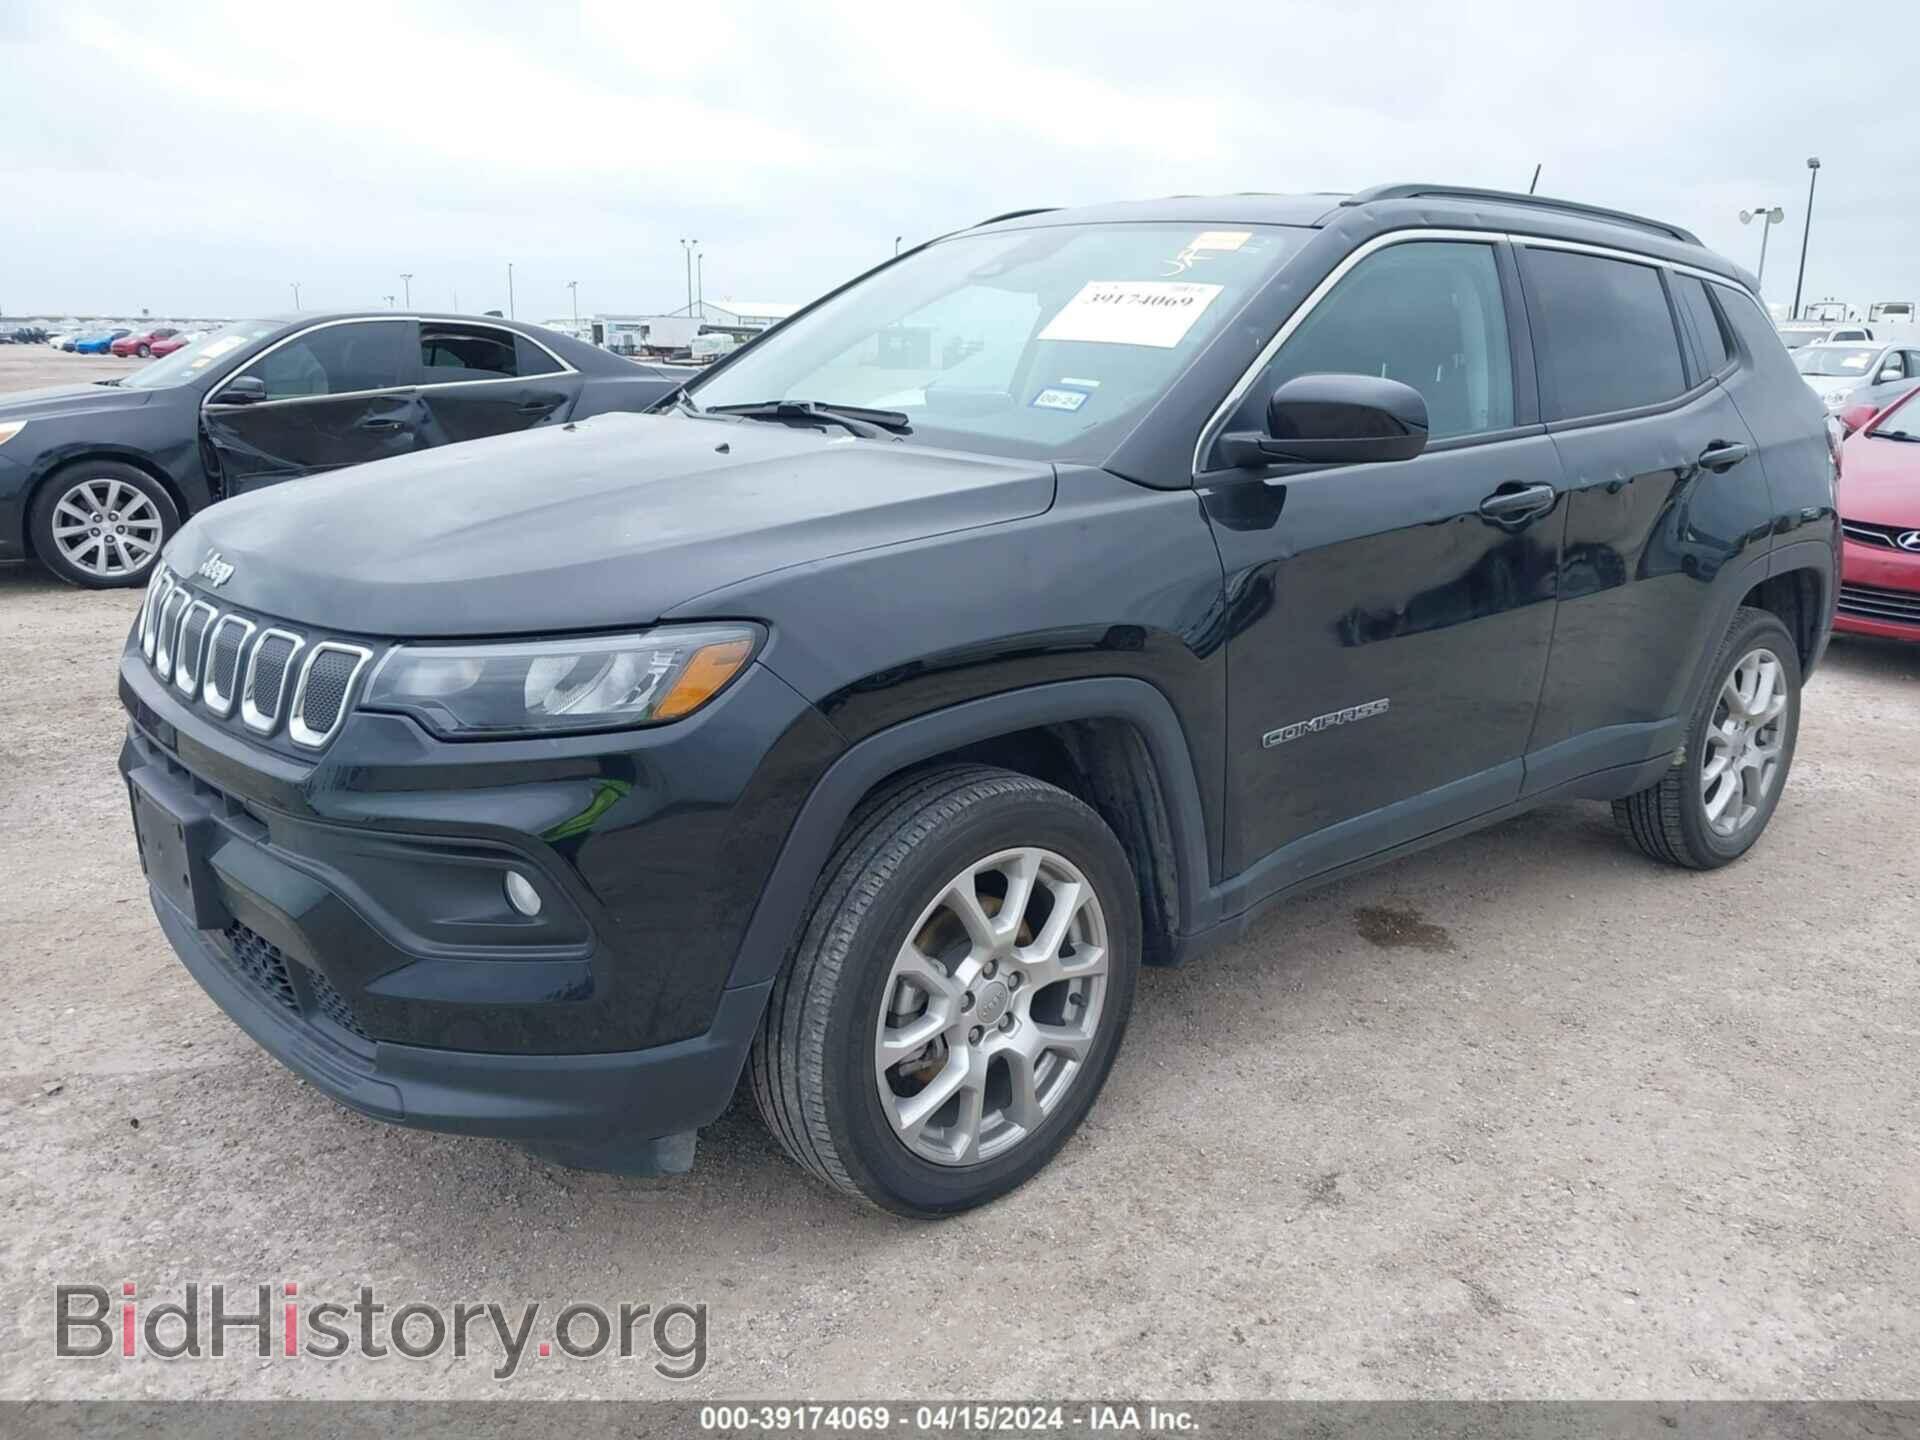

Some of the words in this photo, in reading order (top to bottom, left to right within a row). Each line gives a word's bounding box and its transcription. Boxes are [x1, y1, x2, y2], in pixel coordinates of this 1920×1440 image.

[1086, 292, 1196, 308] 39174069
[198, 547, 234, 588] Jeep
[1261, 698, 1390, 749] COMPASS
